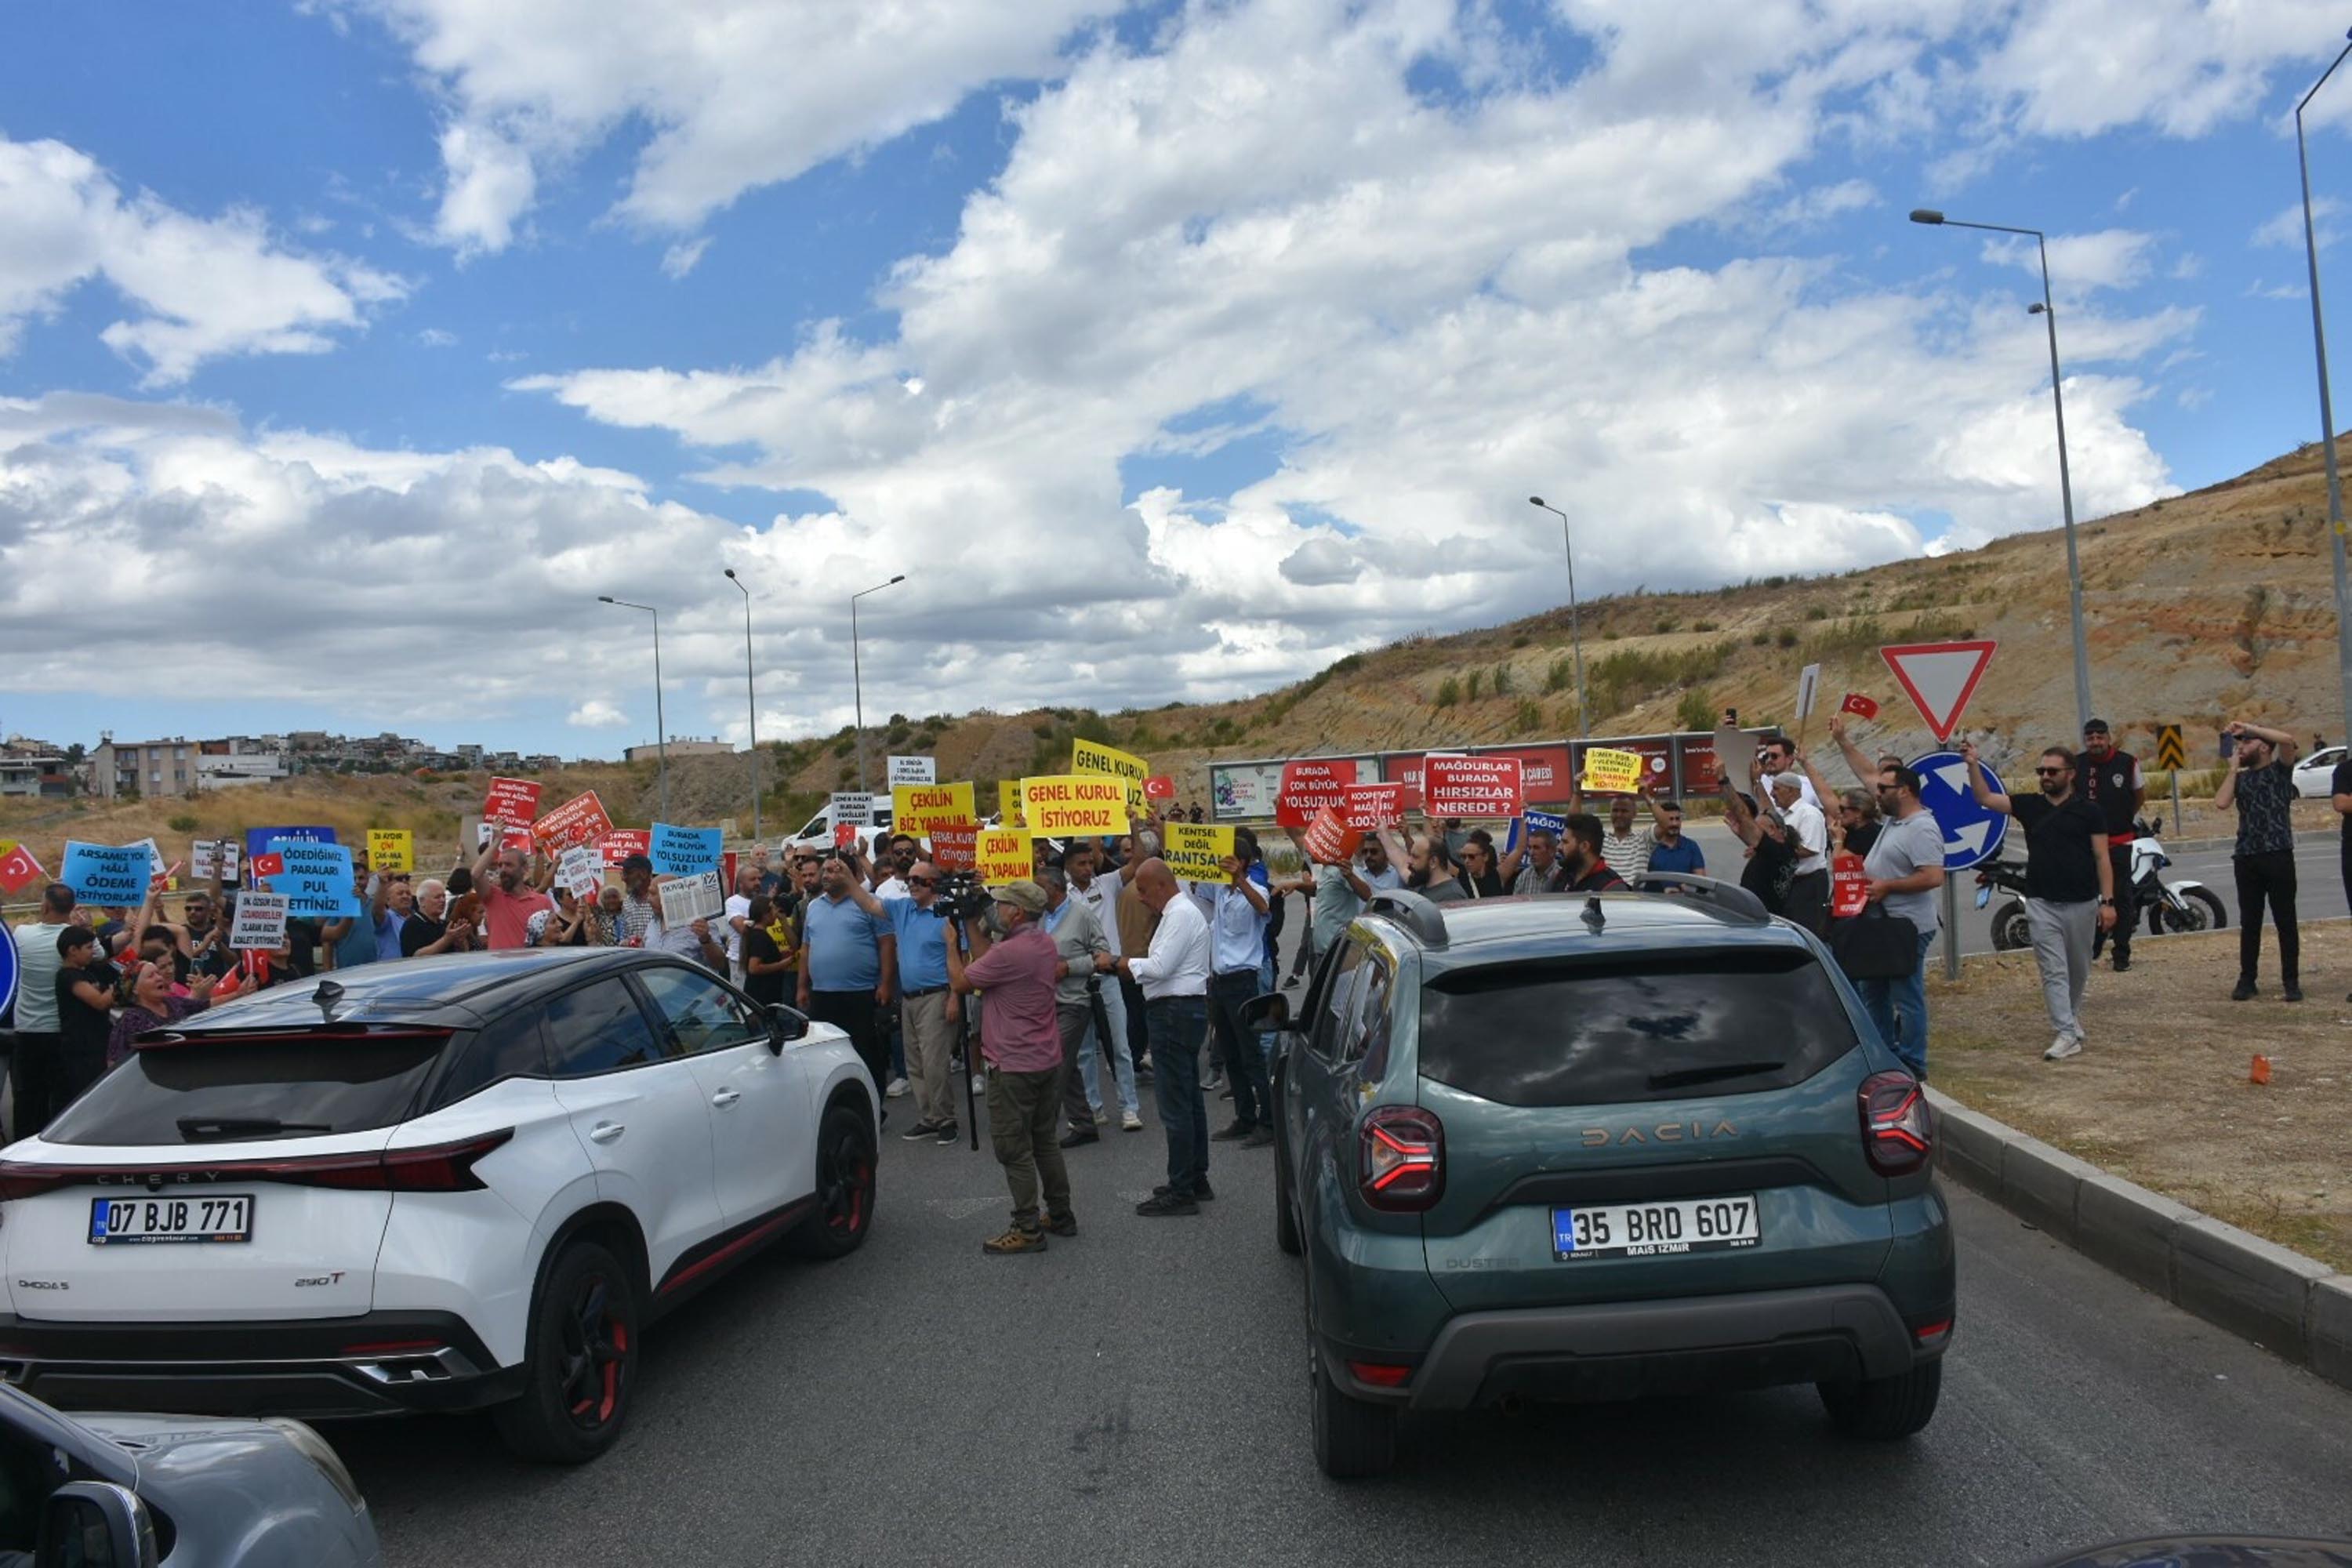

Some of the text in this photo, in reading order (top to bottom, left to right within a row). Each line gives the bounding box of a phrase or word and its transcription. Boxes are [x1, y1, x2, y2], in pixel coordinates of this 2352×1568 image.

[1076, 750, 1112, 773] GENEL
[1433, 760, 1512, 772] MAĞDURLAR
[1296, 766, 1330, 776] BURADA
[1447, 774, 1499, 782] BURADA
[1290, 782, 1307, 792] ÇOK
[1309, 780, 1339, 790] BÜYÜK
[1433, 786, 1514, 798] HIRSIZLAR
[1028, 786, 1071, 802] GENEL
[1076, 784, 1121, 800] KURUL
[910, 789, 953, 811] ÇEKİLİN
[1284, 795, 1346, 808] YOLSUZLUK
[538, 797, 590, 830] MAĞDURLAR
[1436, 802, 1511, 813] NEREDE ?
[549, 811, 586, 833] BURADA
[899, 812, 916, 832] BİZ
[1041, 806, 1111, 828] İSTİYORUZ
[667, 831, 700, 840] BURADA
[931, 831, 955, 844] GENEL
[1178, 827, 1218, 838] KENTSEL
[985, 833, 1018, 857] ÇEKİLİN
[1184, 839, 1211, 850] DEĞİL
[78, 849, 128, 861] ARSAMIZ
[284, 848, 343, 861] ÖDEDİĞİMİZ
[655, 850, 713, 863] YOLSUZLUK
[291, 865, 339, 876] PARALARI
[669, 863, 688, 873] VAR
[992, 862, 1030, 879] YAPALIM
[1173, 867, 1222, 880] DÖNÜŞÜM
[85, 874, 138, 888] ÖDEME
[303, 880, 328, 893] PUL
[289, 896, 339, 910] ETTİNİZ!
[1581, 1120, 1738, 1148] DACIA
[97, 1171, 220, 1185] CHERY
[108, 1200, 243, 1232] 07 BJB 771
[1573, 1202, 1748, 1247] 35 BRD 607
[1559, 1233, 1572, 1243] TR
[1446, 1257, 1519, 1269] DUSTER
